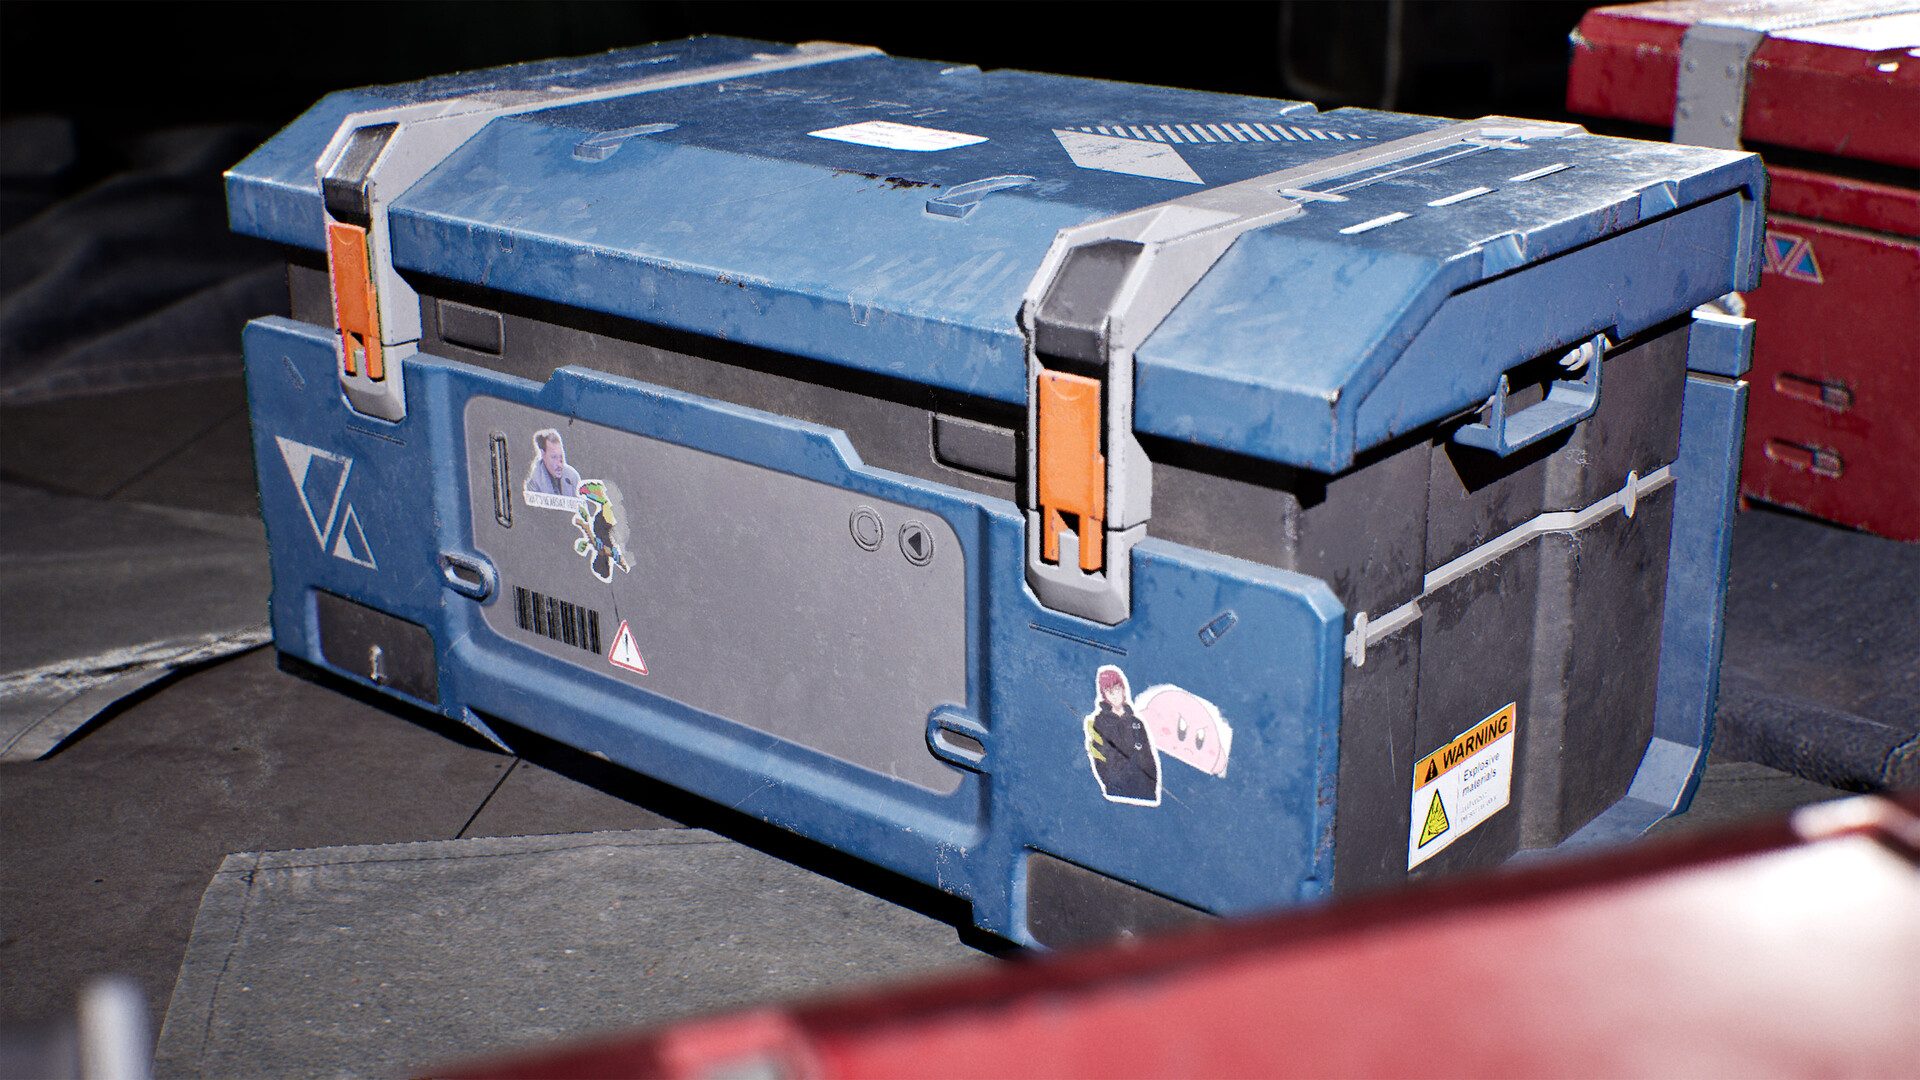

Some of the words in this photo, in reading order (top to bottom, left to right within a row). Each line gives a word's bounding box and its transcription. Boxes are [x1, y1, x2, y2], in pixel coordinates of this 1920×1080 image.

[1443, 715, 1508, 769] WARNING
[1462, 767, 1497, 797] materials
[1463, 753, 1500, 782] Explosive
